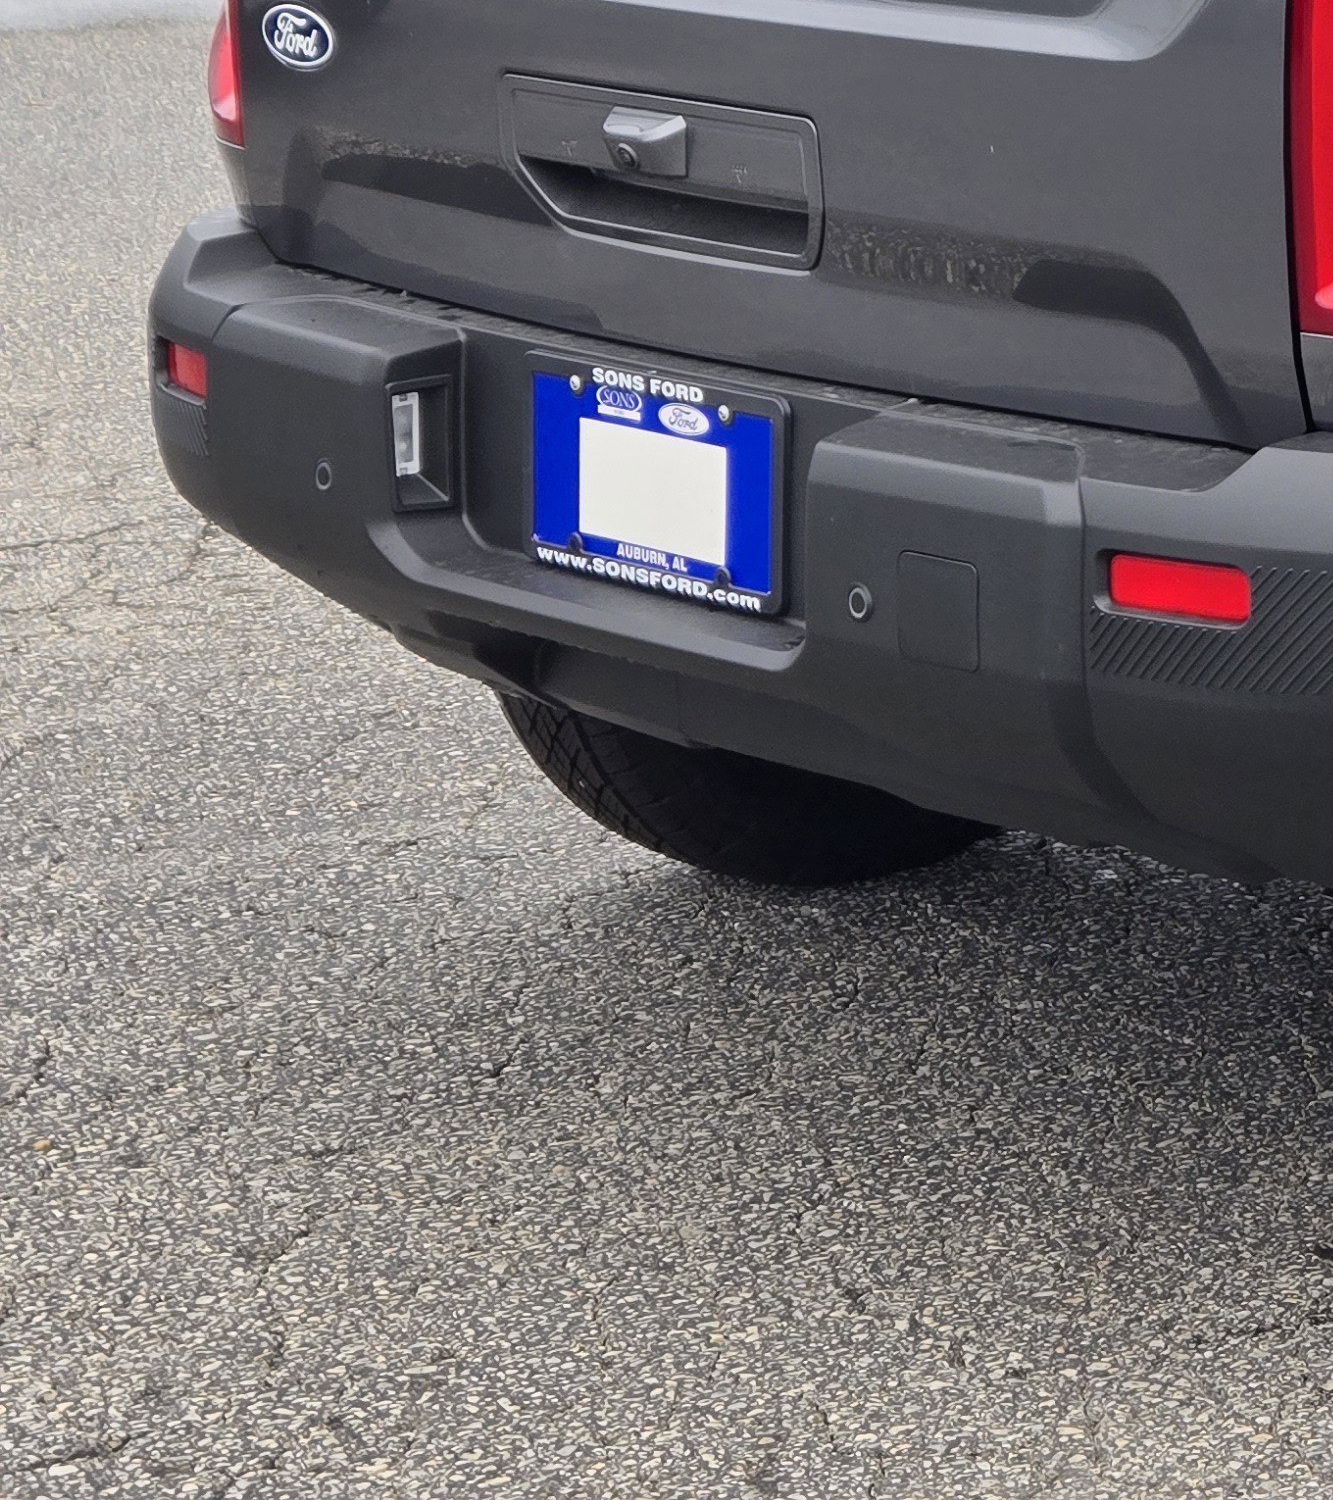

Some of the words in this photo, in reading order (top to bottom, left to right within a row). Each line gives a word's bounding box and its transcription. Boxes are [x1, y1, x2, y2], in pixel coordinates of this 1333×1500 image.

[273, 12, 319, 58] Ford
[592, 367, 645, 392] SONS
[649, 378, 704, 403] FORD
[602, 388, 636, 409] SONS
[668, 407, 699, 431] Ford
[616, 542, 669, 571] AUBURN,
[671, 556, 689, 573] AL
[536, 546, 763, 613] www.SONSFORD.com
